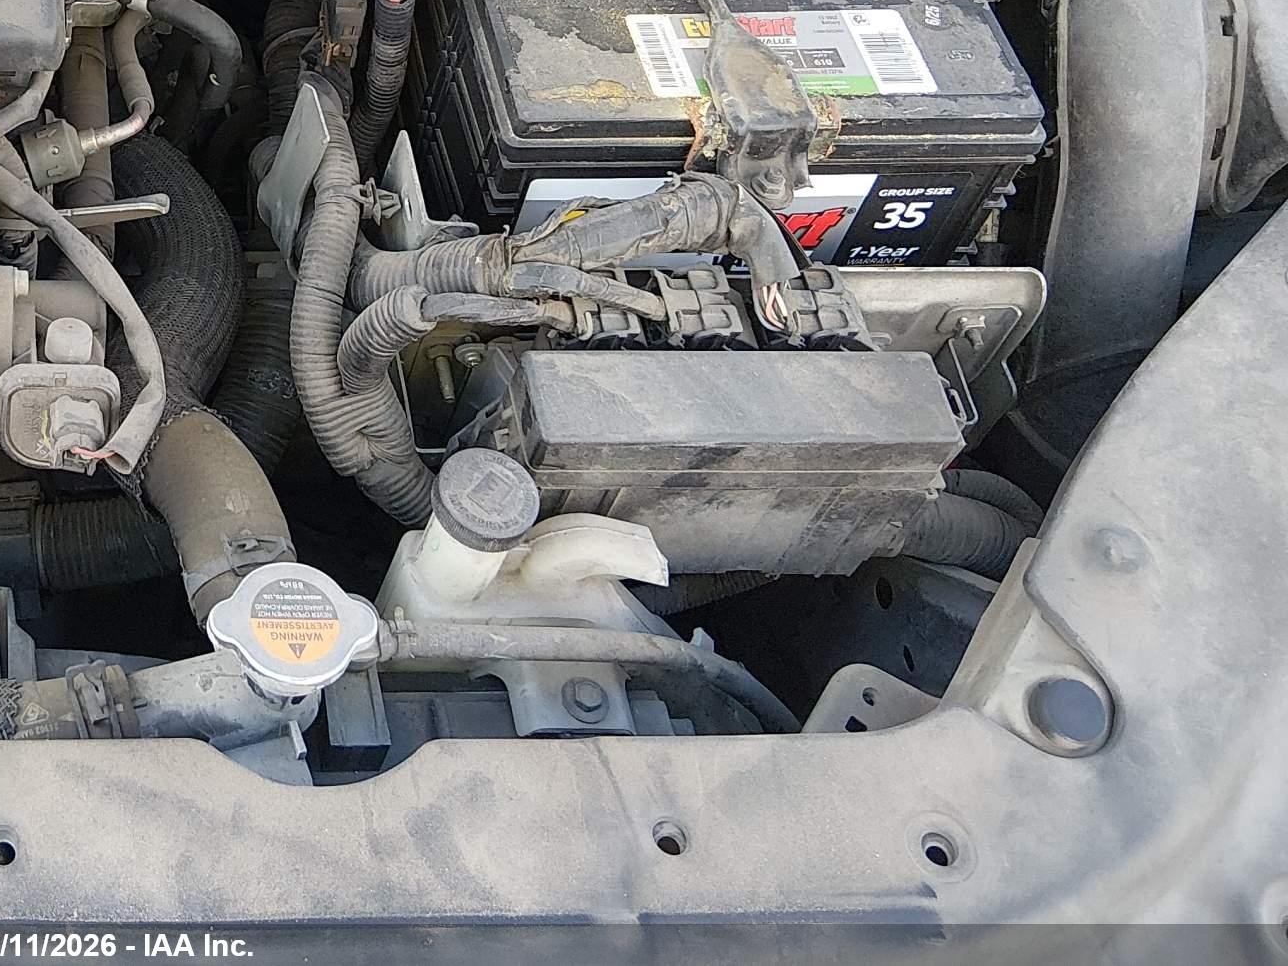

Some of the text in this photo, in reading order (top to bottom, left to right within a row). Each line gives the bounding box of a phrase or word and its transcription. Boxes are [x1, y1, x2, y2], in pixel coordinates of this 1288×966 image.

[925, 4, 940, 26] 6/25
[814, 58, 833, 66] 610
[878, 187, 955, 197] GROUP SIZE
[873, 202, 934, 229] 35
[849, 245, 920, 258] 1-Year
[847, 257, 906, 265] WARRANTY
[257, 621, 334, 630] AVERTISSEMENT
[270, 631, 324, 641] WARNING
